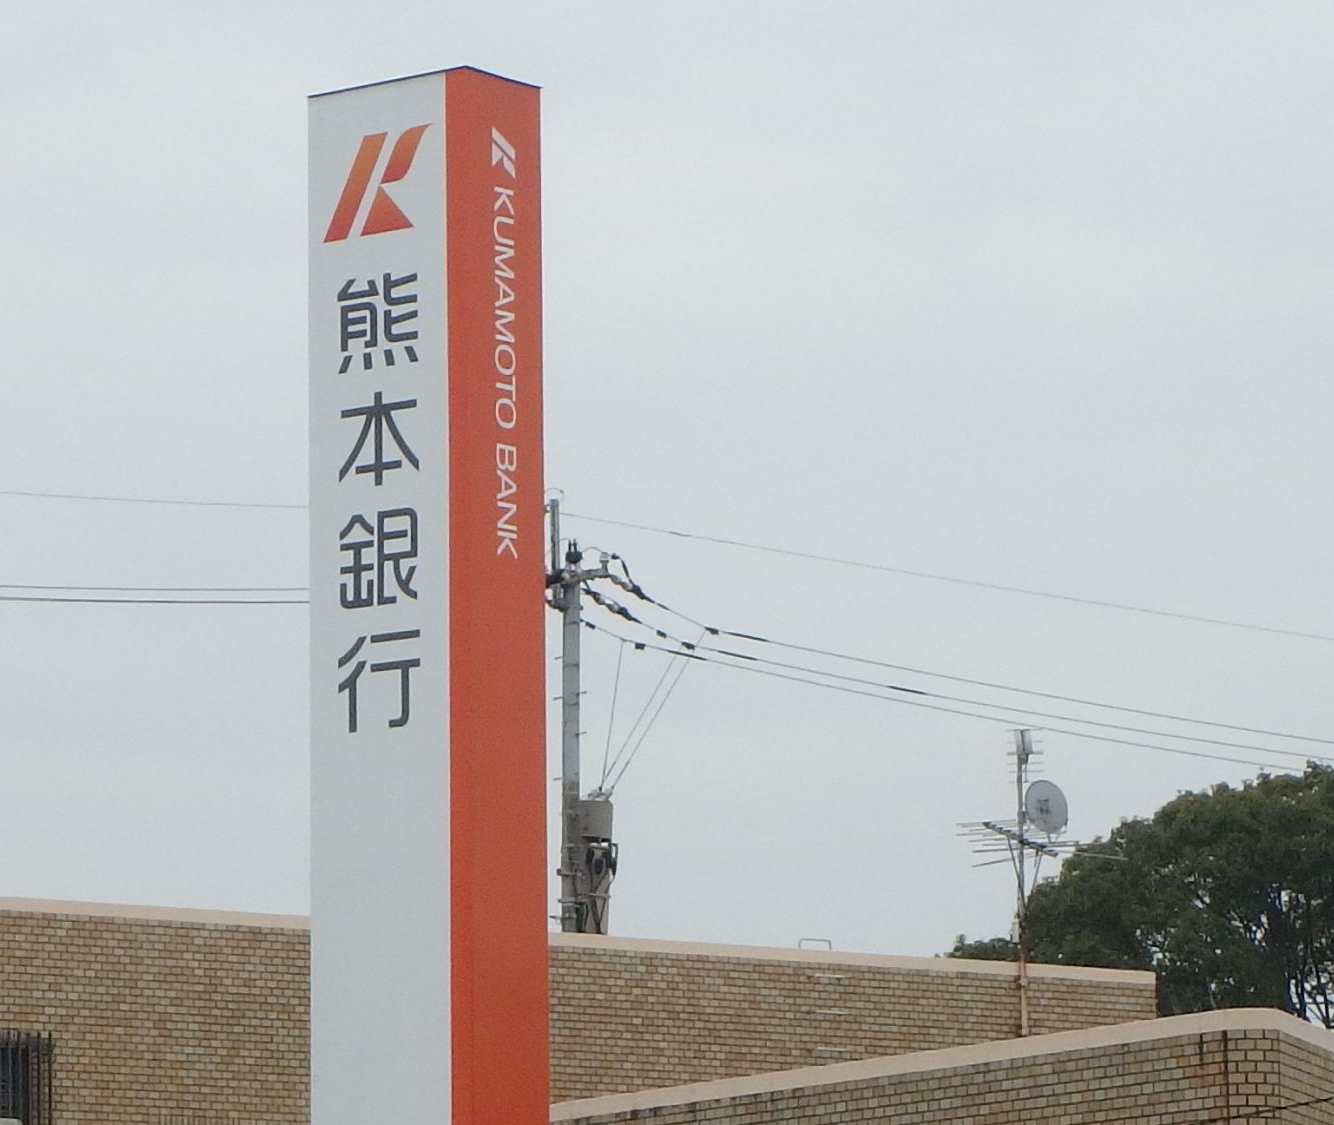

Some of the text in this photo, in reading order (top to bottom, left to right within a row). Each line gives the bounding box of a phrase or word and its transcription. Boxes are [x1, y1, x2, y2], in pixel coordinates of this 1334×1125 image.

[337, 270, 421, 733] 熊本銀行
[493, 186, 519, 560] KUMAMOTO BANK
